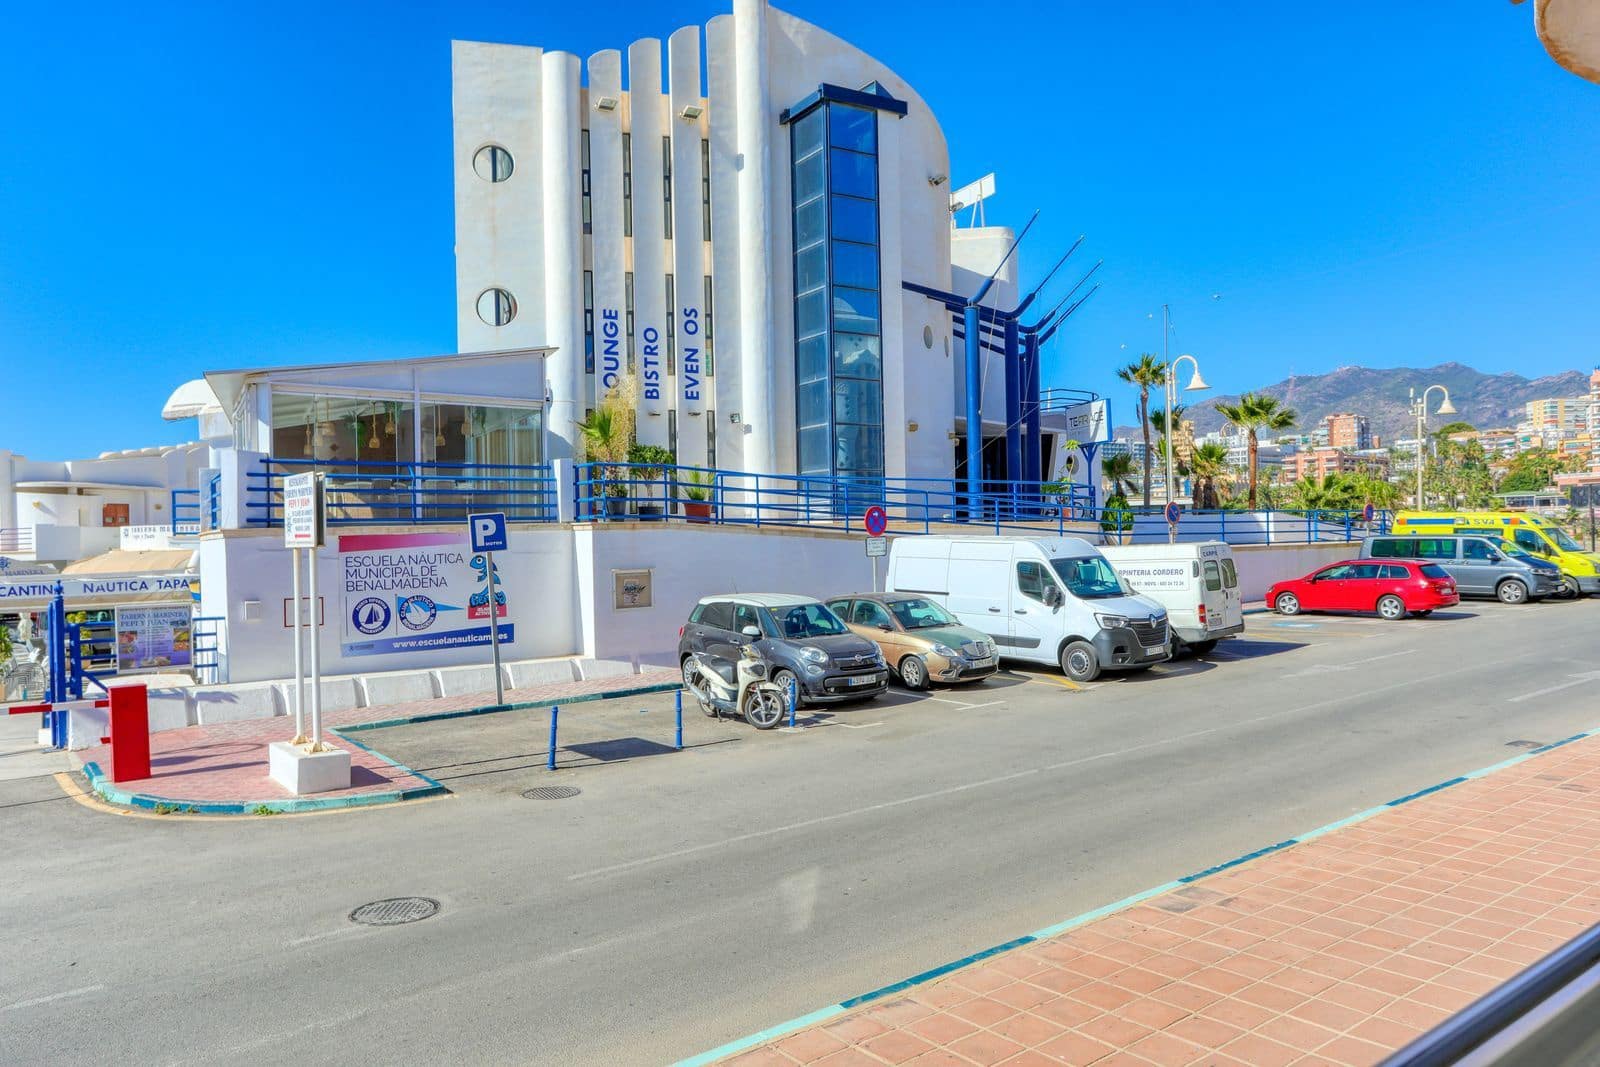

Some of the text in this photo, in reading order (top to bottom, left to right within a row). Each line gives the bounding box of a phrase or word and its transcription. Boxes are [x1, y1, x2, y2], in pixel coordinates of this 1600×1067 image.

[602, 308, 620, 398] OUNGE
[643, 327, 659, 400] BISTRO
[474, 518, 497, 547] P
[345, 554, 407, 568] ESCUELA
[345, 565, 438, 580] MUNICIPAL DE
[1152, 568, 1184, 576] CORDERO
[0, 584, 64, 598] CANTIN
